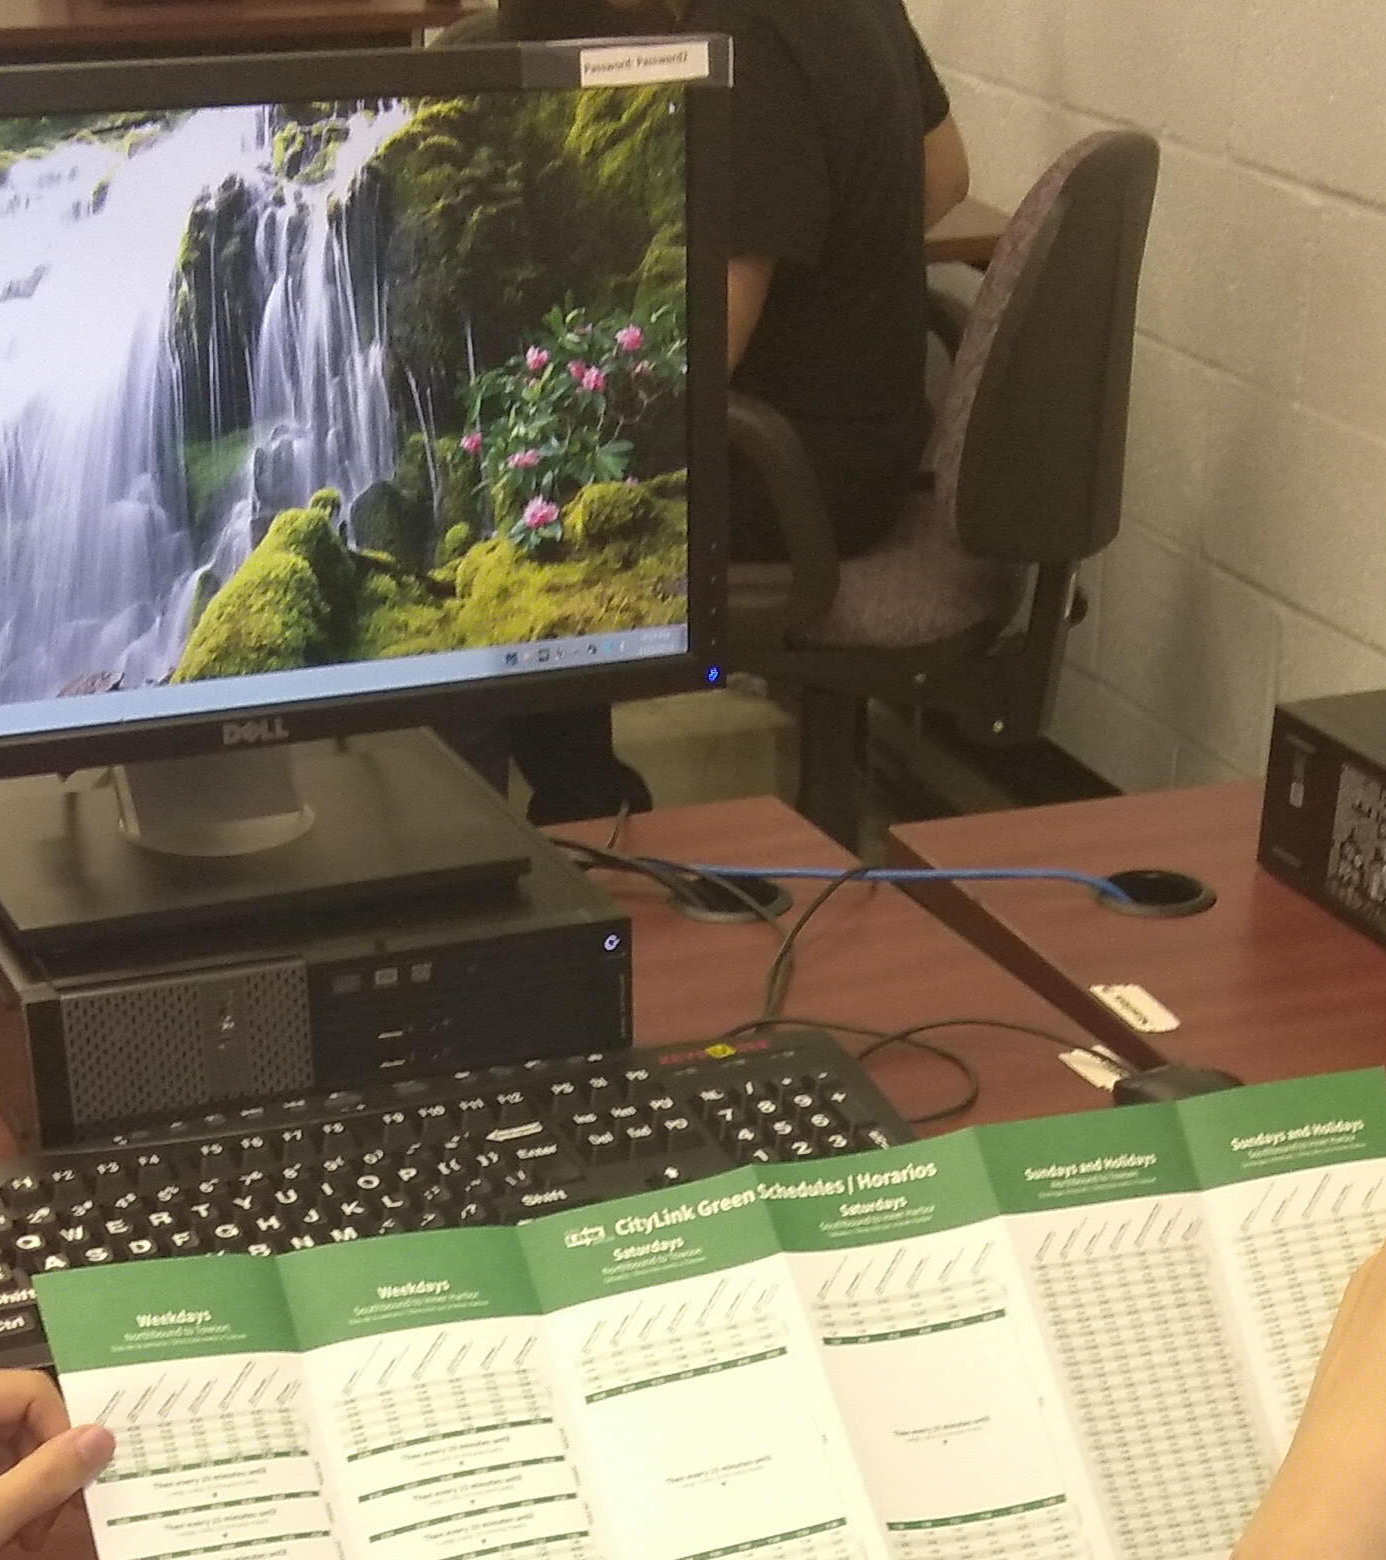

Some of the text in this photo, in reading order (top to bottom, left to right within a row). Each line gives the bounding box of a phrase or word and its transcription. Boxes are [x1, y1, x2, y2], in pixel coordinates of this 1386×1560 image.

[1230, 1130, 1287, 1152] Sundays
[1287, 1124, 1311, 1142] and
[1311, 1118, 1365, 1137] Holidays
[1024, 1163, 1079, 1182] Sundays
[1079, 1157, 1103, 1174] and
[1103, 1152, 1158, 1170] Holidays
[614, 1202, 698, 1236] CityLink
[697, 1187, 757, 1218] Green
[757, 1176, 846, 1201] Schedules
[857, 1160, 938, 1191] Horarios
[839, 1195, 909, 1218] Saturdays
[16, 1233, 43, 1250] Q
[59, 1224, 84, 1243] W
[105, 1218, 129, 1234] E
[148, 1211, 173, 1227] R
[190, 1202, 211, 1218] T
[232, 1195, 253, 1210] Y
[275, 1188, 298, 1205] U
[44, 1253, 68, 1270] A
[85, 1246, 110, 1263] S
[128, 1238, 153, 1255] D
[171, 1230, 192, 1248] F
[256, 1214, 282, 1232] H
[341, 1199, 365, 1216] K
[381, 1195, 404, 1209] L
[613, 1236, 685, 1261] Saturdays
[376, 1279, 451, 1300] Weekdays
[135, 1309, 212, 1329] Weekdays
